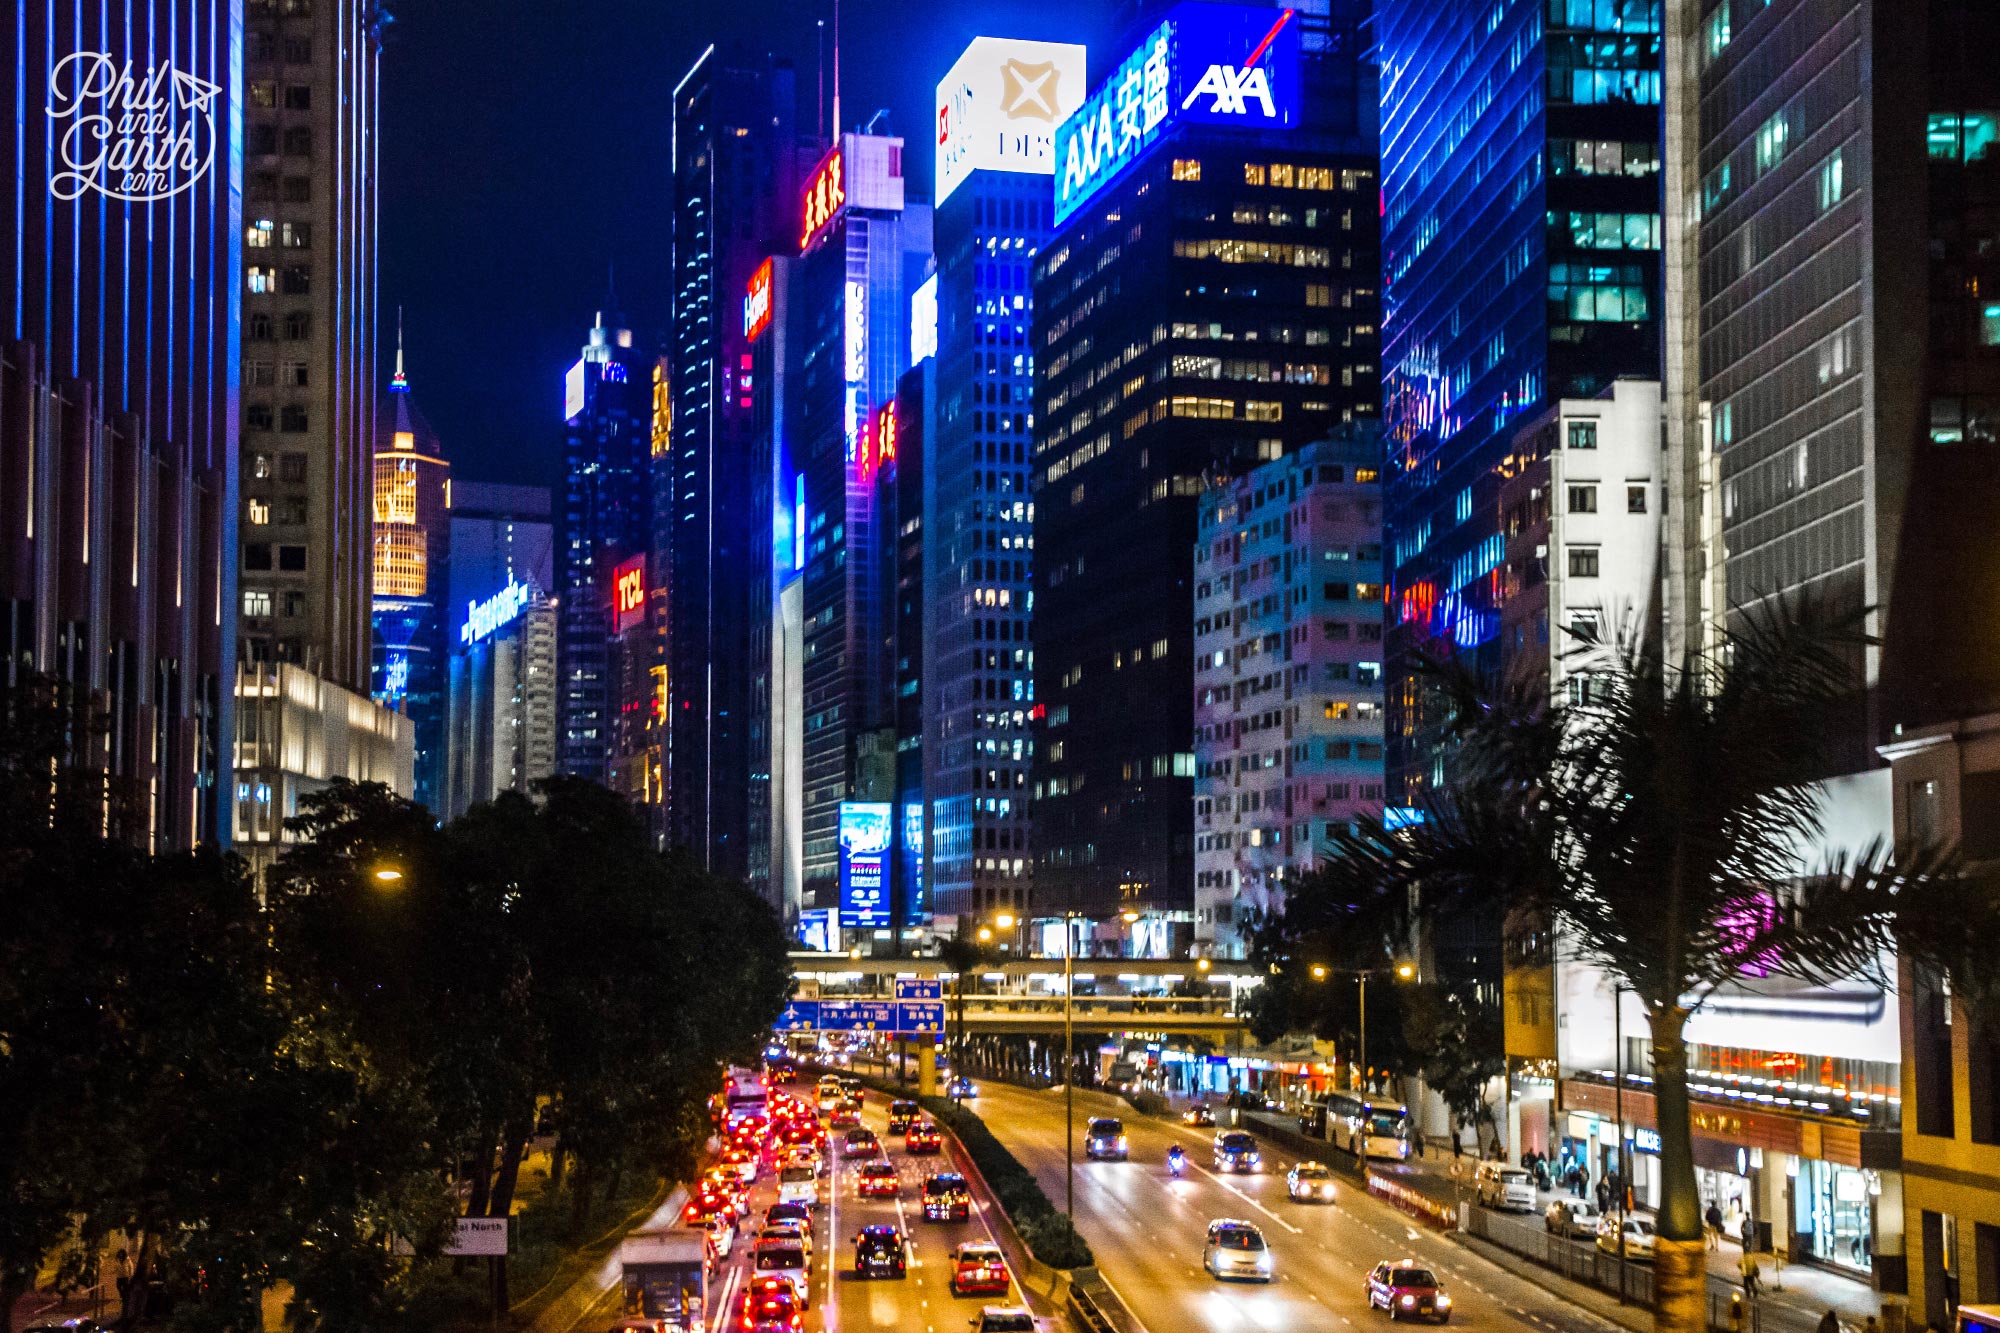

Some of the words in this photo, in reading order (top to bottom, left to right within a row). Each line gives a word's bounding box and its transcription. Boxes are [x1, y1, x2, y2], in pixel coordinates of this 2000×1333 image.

[1063, 102, 1113, 201] AXA
[1118, 36, 1169, 156] 安盛
[1181, 64, 1276, 117] AXA
[744, 276, 769, 336] Haier
[468, 579, 519, 645] Panasonic
[618, 568, 644, 611] TCL
[471, 1222, 502, 1231] North
